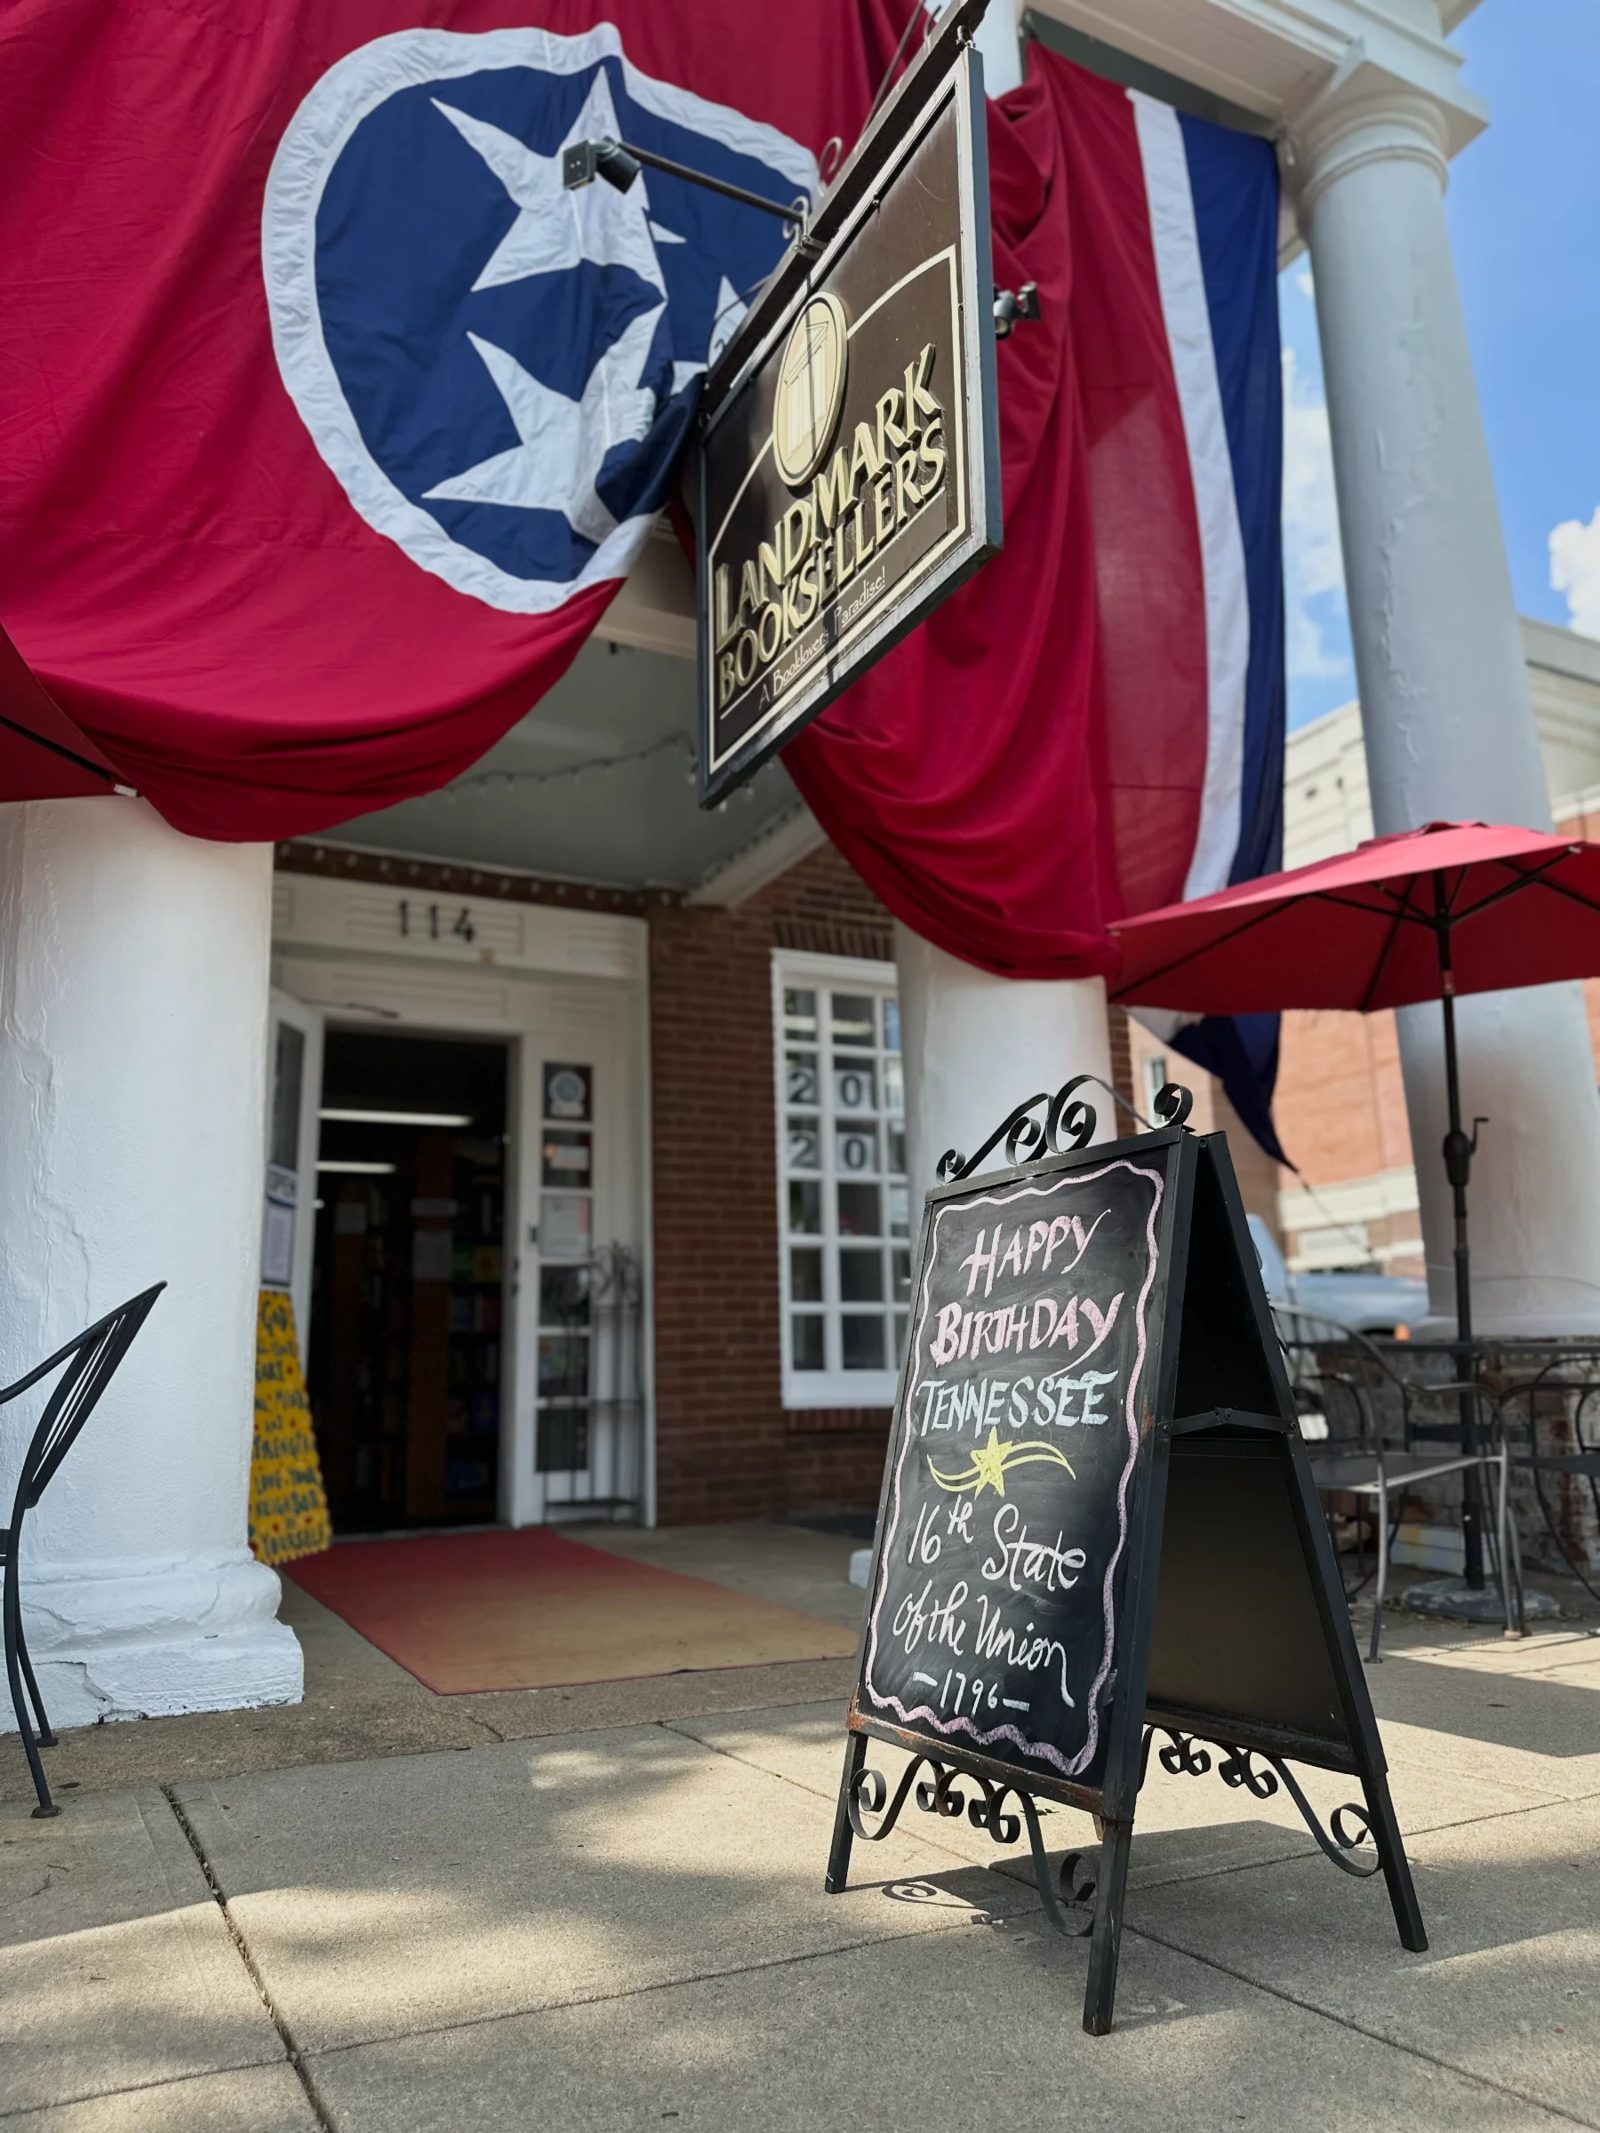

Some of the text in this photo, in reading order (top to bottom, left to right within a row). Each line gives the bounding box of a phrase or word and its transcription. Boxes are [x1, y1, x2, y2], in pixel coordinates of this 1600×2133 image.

[714, 342, 942, 652] LANDMARK
[718, 417, 946, 711] BOOKSELLERS
[758, 683, 771, 711] A
[833, 565, 886, 636] Paradise!
[398, 899, 476, 944] 114
[957, 1208, 1112, 1299] HAPPY
[929, 1291, 1125, 1378] BIRTHDAY
[915, 1370, 1119, 1439] TENNESSEE
[907, 1494, 1087, 1592] 16th State
[893, 1579, 1076, 1708] of the Union
